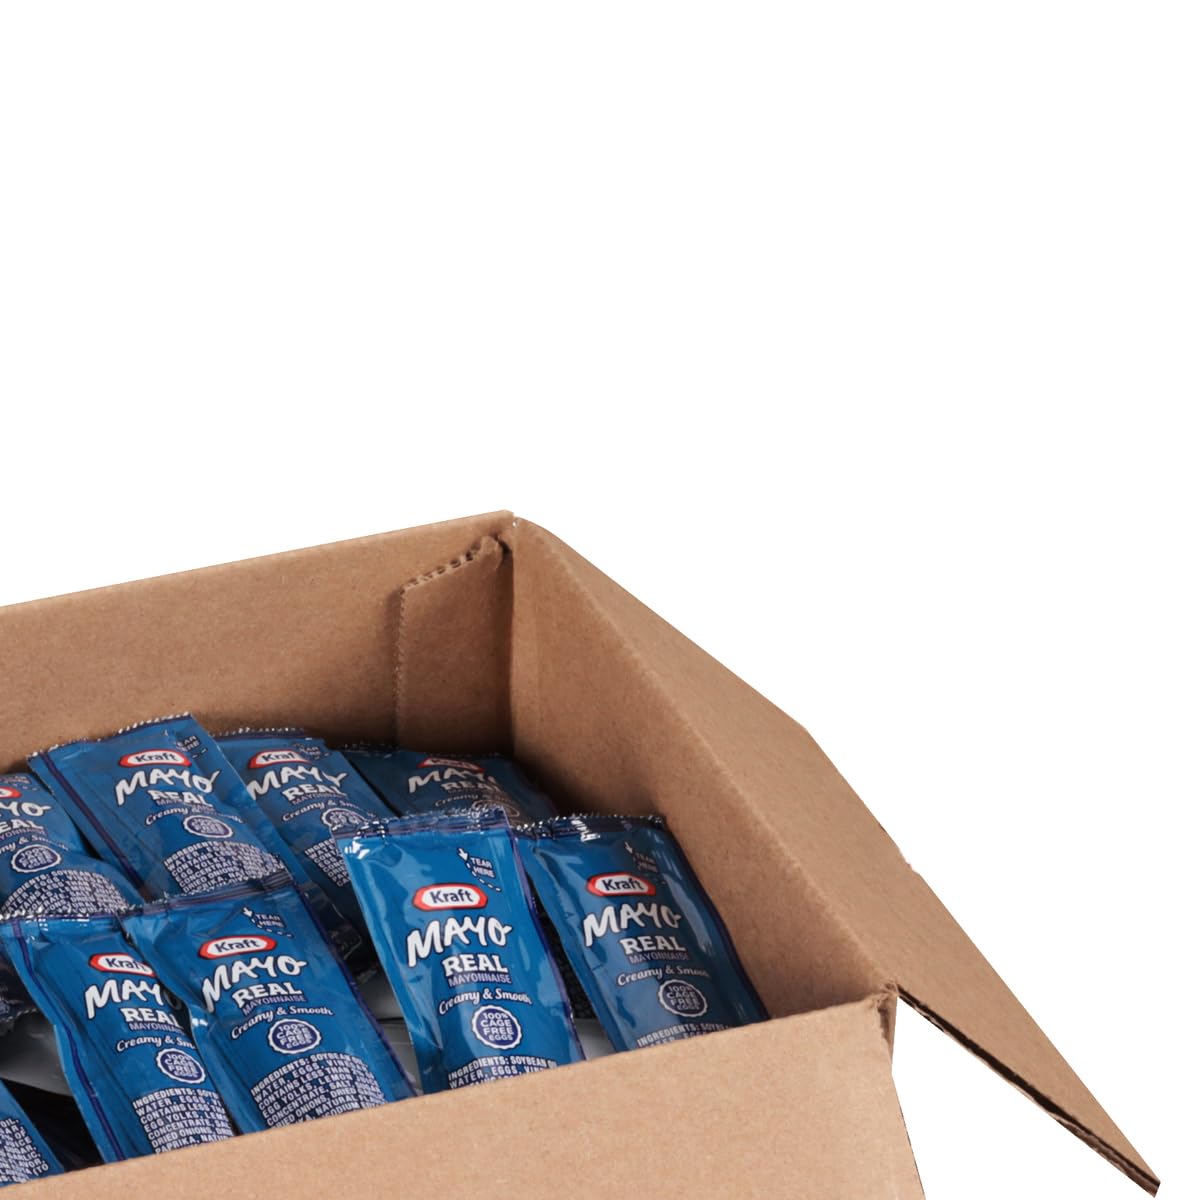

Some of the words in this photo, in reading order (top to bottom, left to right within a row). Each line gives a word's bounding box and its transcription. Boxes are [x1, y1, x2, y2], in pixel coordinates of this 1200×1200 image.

[135, 752, 178, 762] Kraft
[115, 769, 220, 806] MAYO
[145, 807, 188, 825] Creamy
[282, 801, 325, 822] Creamy
[19, 835, 28, 843] &
[471, 857, 492, 869] TEAR
[473, 866, 496, 879] HERE
[602, 877, 644, 891] Kraft
[430, 889, 473, 903] Kraft
[583, 902, 681, 947] MAYO
[215, 938, 259, 953] Kraft
[407, 915, 512, 968] MAYO
[620, 935, 686, 954] REAL
[442, 954, 508, 977] REAL
[448, 973, 512, 987] MAYONNAISE
[618, 966, 663, 986] Creamy
[665, 965, 675, 974] &
[202, 956, 308, 1014] MAYO
[232, 982, 302, 1009] REAL
[439, 989, 479, 1015] Creamy
[483, 989, 493, 999] &
[666, 991, 696, 999] CAGE
[242, 995, 307, 1015] MAYONNAISE
[231, 1011, 274, 1039] Creamy
[277, 1007, 288, 1016] &
[290, 1006, 333, 1015] Smooth
[480, 1019, 511, 1028] CAGE
[484, 1027, 514, 1035] FREE
[116, 1035, 161, 1052] Creamy
[165, 1034, 175, 1044] &
[251, 1058, 310, 1096] INGREDIENTS:
